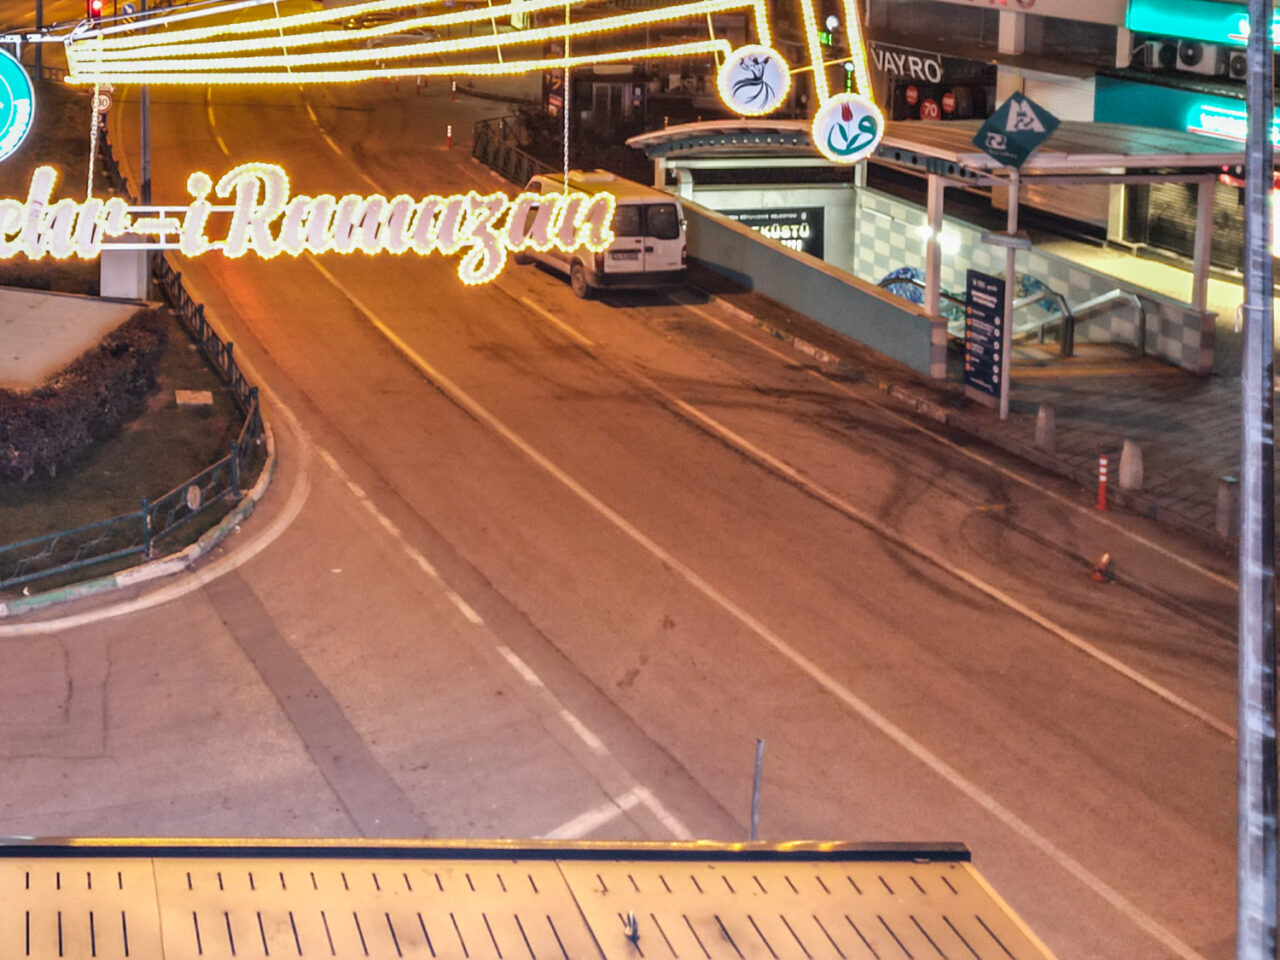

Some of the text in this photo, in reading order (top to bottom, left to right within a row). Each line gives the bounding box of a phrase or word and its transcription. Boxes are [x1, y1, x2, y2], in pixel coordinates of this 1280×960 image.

[871, 49, 942, 83] VAYRO
[923, 102, 938, 117] 70
[215, 162, 617, 286] Ramazan
